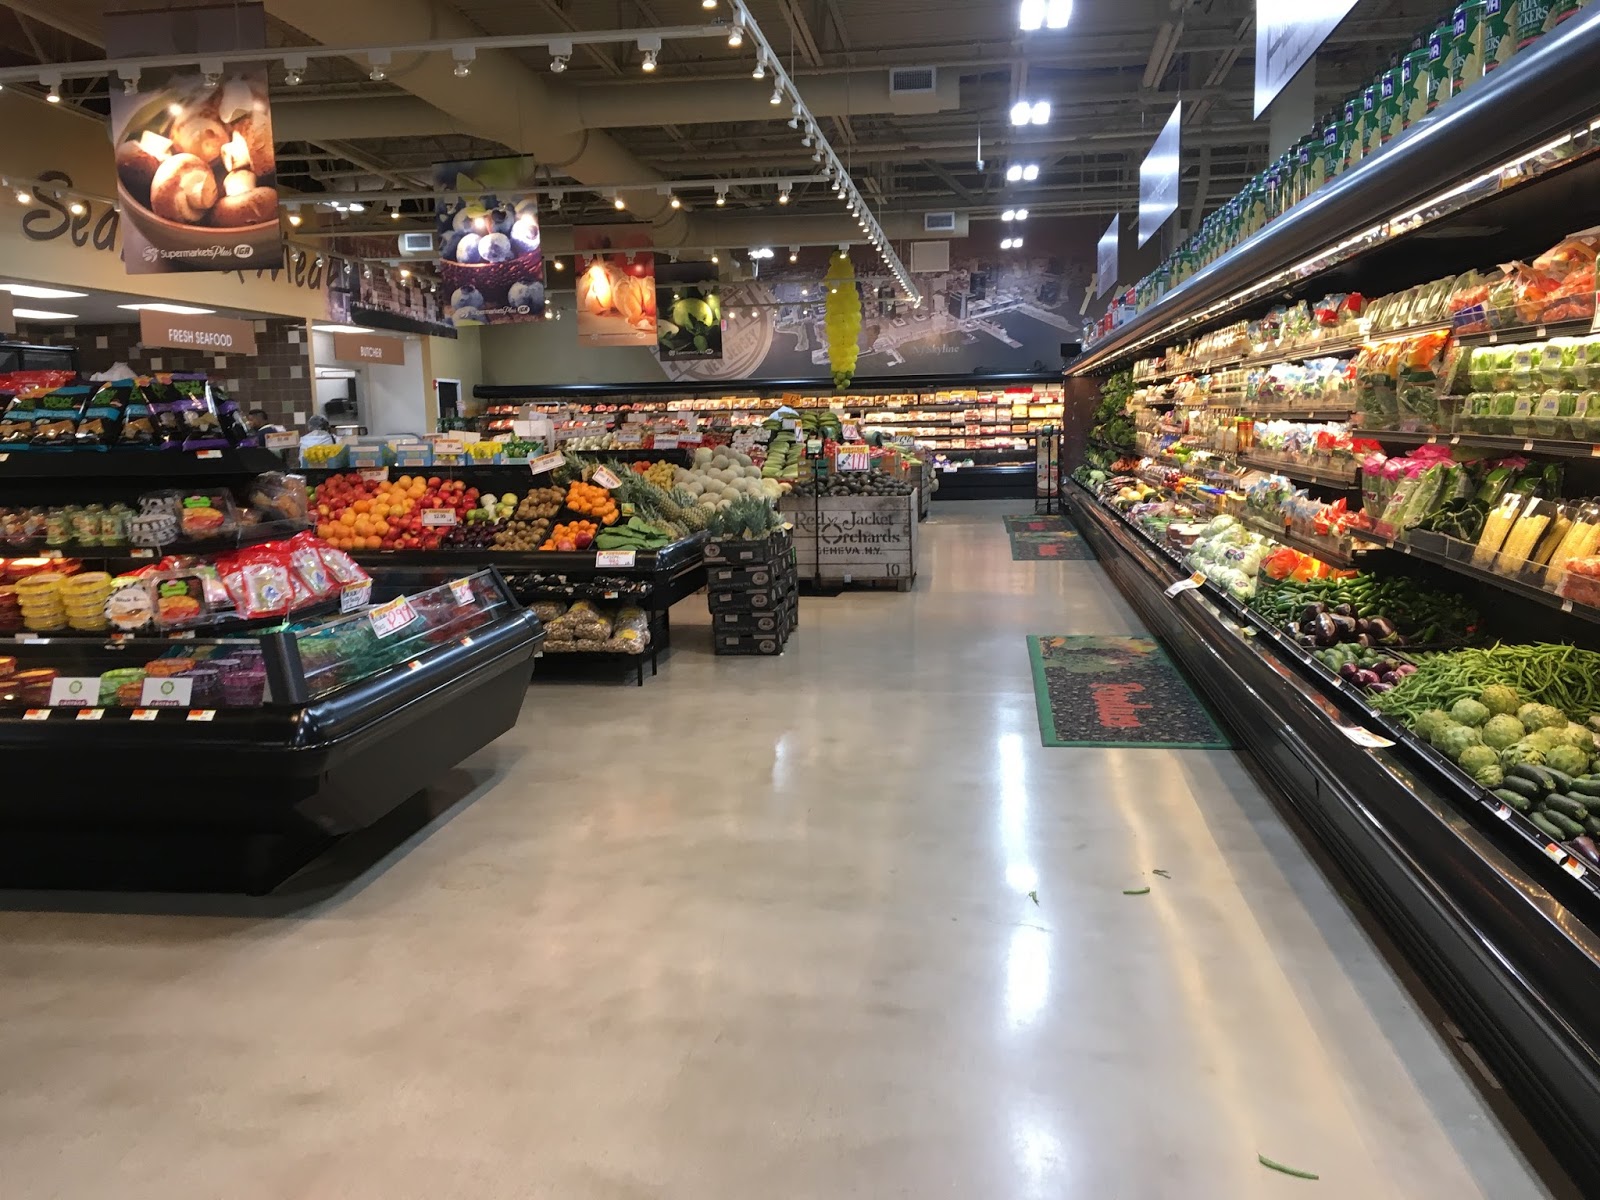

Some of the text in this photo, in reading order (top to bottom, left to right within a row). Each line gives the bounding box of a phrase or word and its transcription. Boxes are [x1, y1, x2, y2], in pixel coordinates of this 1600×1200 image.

[168, 328, 233, 347] FRESH SEAFOOD
[360, 345, 382, 359] BUTCHER
[842, 511, 894, 530] Jacket
[821, 521, 901, 545] Orchards
[885, 563, 900, 577] 10
